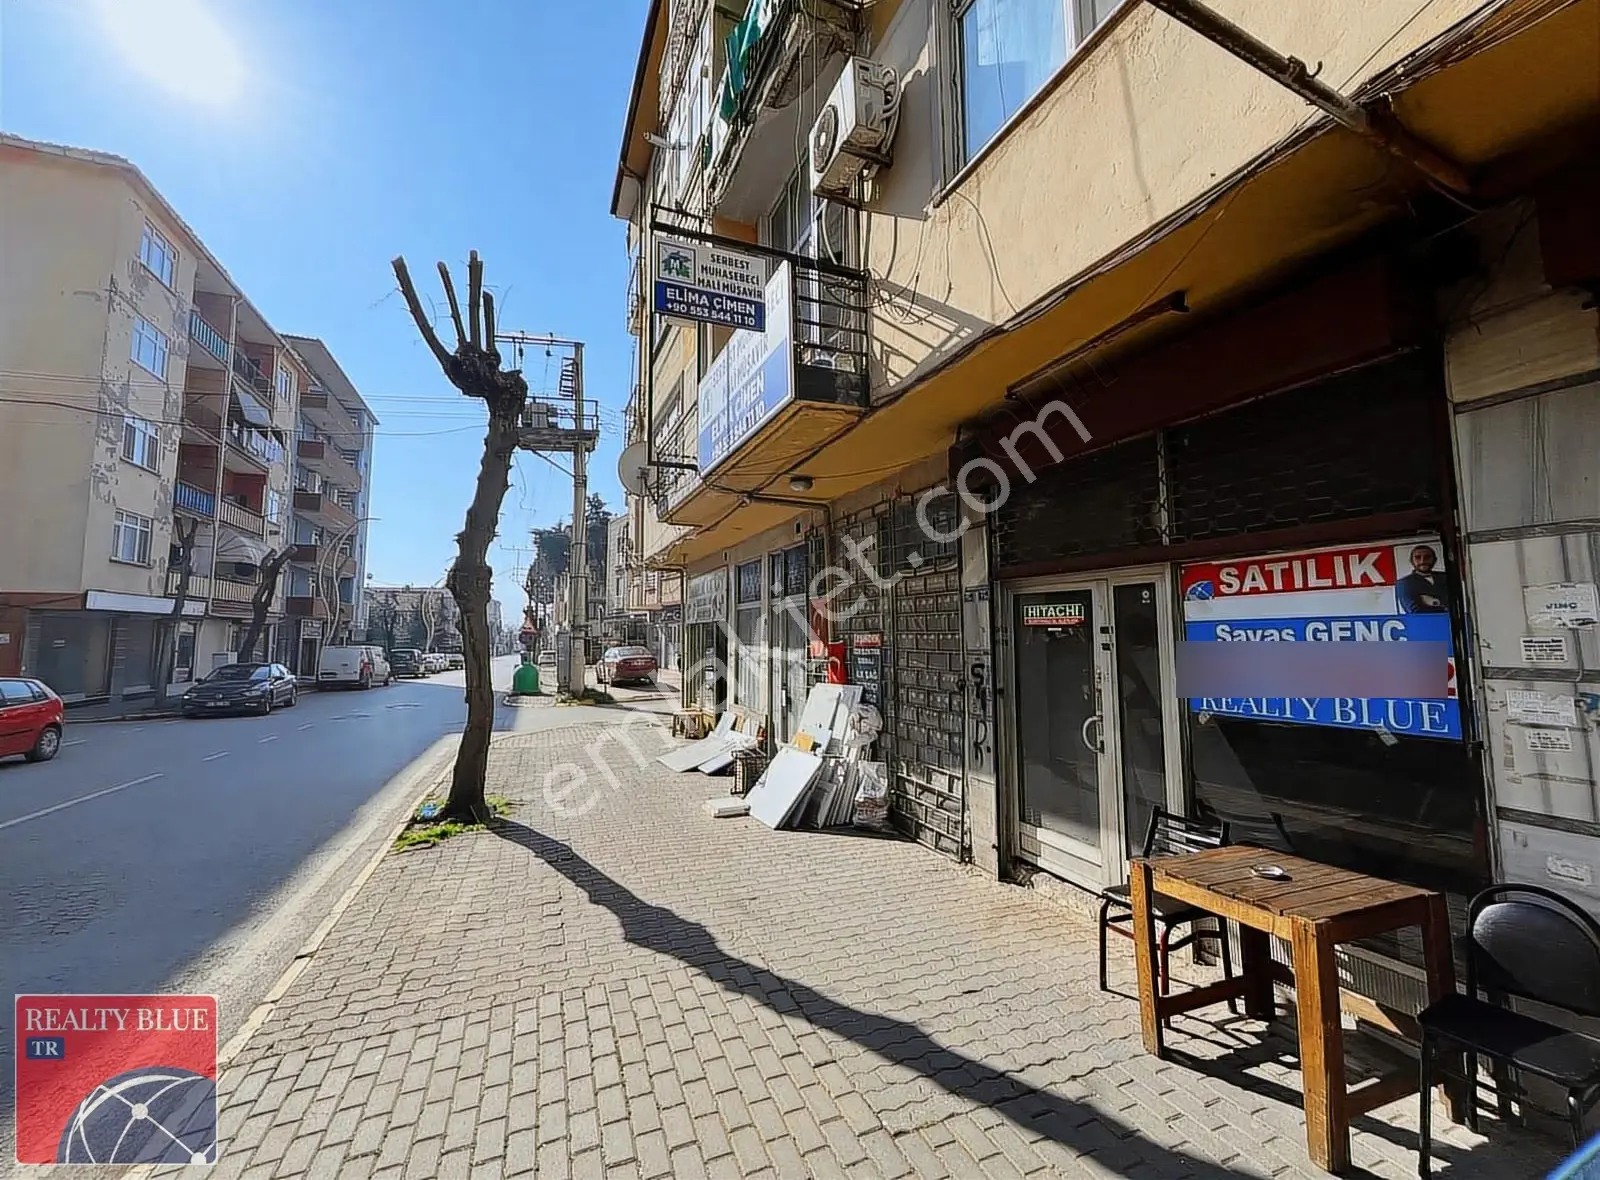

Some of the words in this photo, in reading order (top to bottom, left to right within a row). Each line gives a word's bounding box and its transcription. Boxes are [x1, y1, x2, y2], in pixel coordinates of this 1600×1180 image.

[710, 253, 750, 270] SERBEST
[700, 264, 760, 286] MUHASEBECİ
[666, 286, 709, 307] ELİMA
[713, 295, 755, 317] ÇİMEN
[666, 302, 687, 313] +90
[690, 305, 709, 317] 553
[711, 310, 731, 322] 544
[733, 314, 741, 324] 11
[744, 316, 755, 326] 10
[1218, 552, 1387, 595] SATILIK
[1028, 604, 1079, 617] HITACHI
[1332, 699, 1449, 732] BLUE
